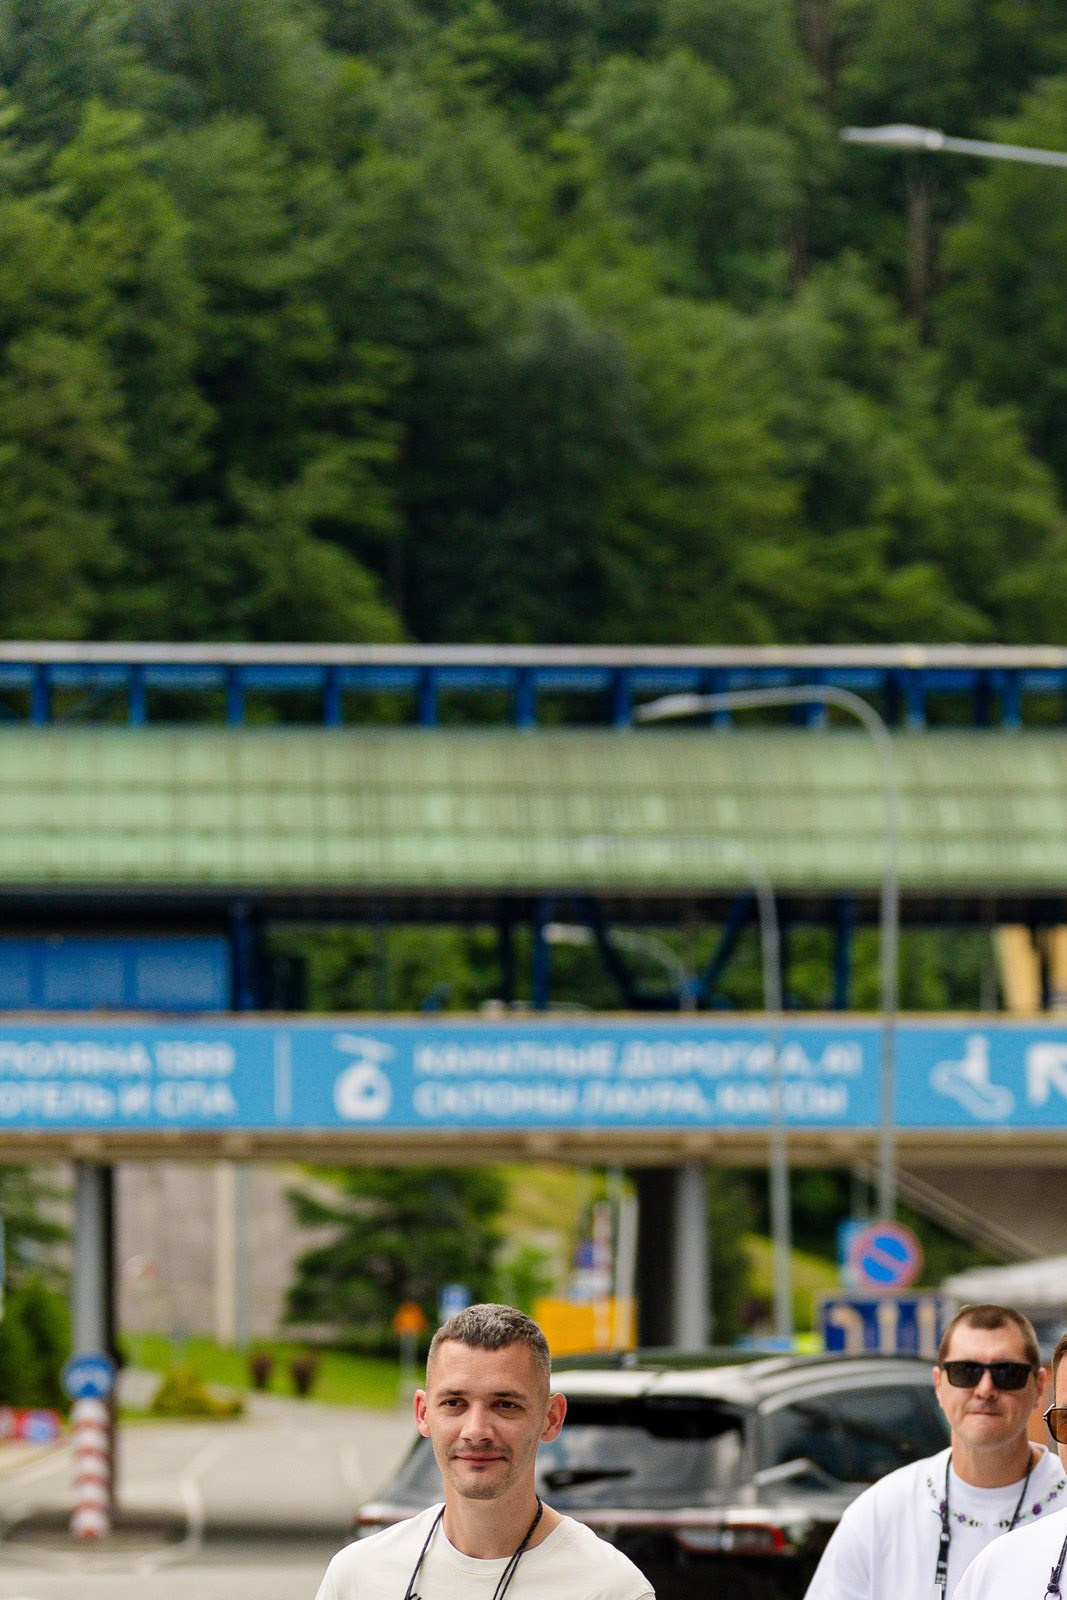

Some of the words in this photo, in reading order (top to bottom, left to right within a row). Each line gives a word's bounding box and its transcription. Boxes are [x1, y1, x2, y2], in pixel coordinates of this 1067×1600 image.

[413, 1041, 616, 1076] КАНАТНЫЕ
[619, 1041, 775, 1078] ДОРОГИ
[119, 1083, 151, 1118] И
[154, 1081, 237, 1118] СПА
[413, 1081, 579, 1117] СКЛОНЫ
